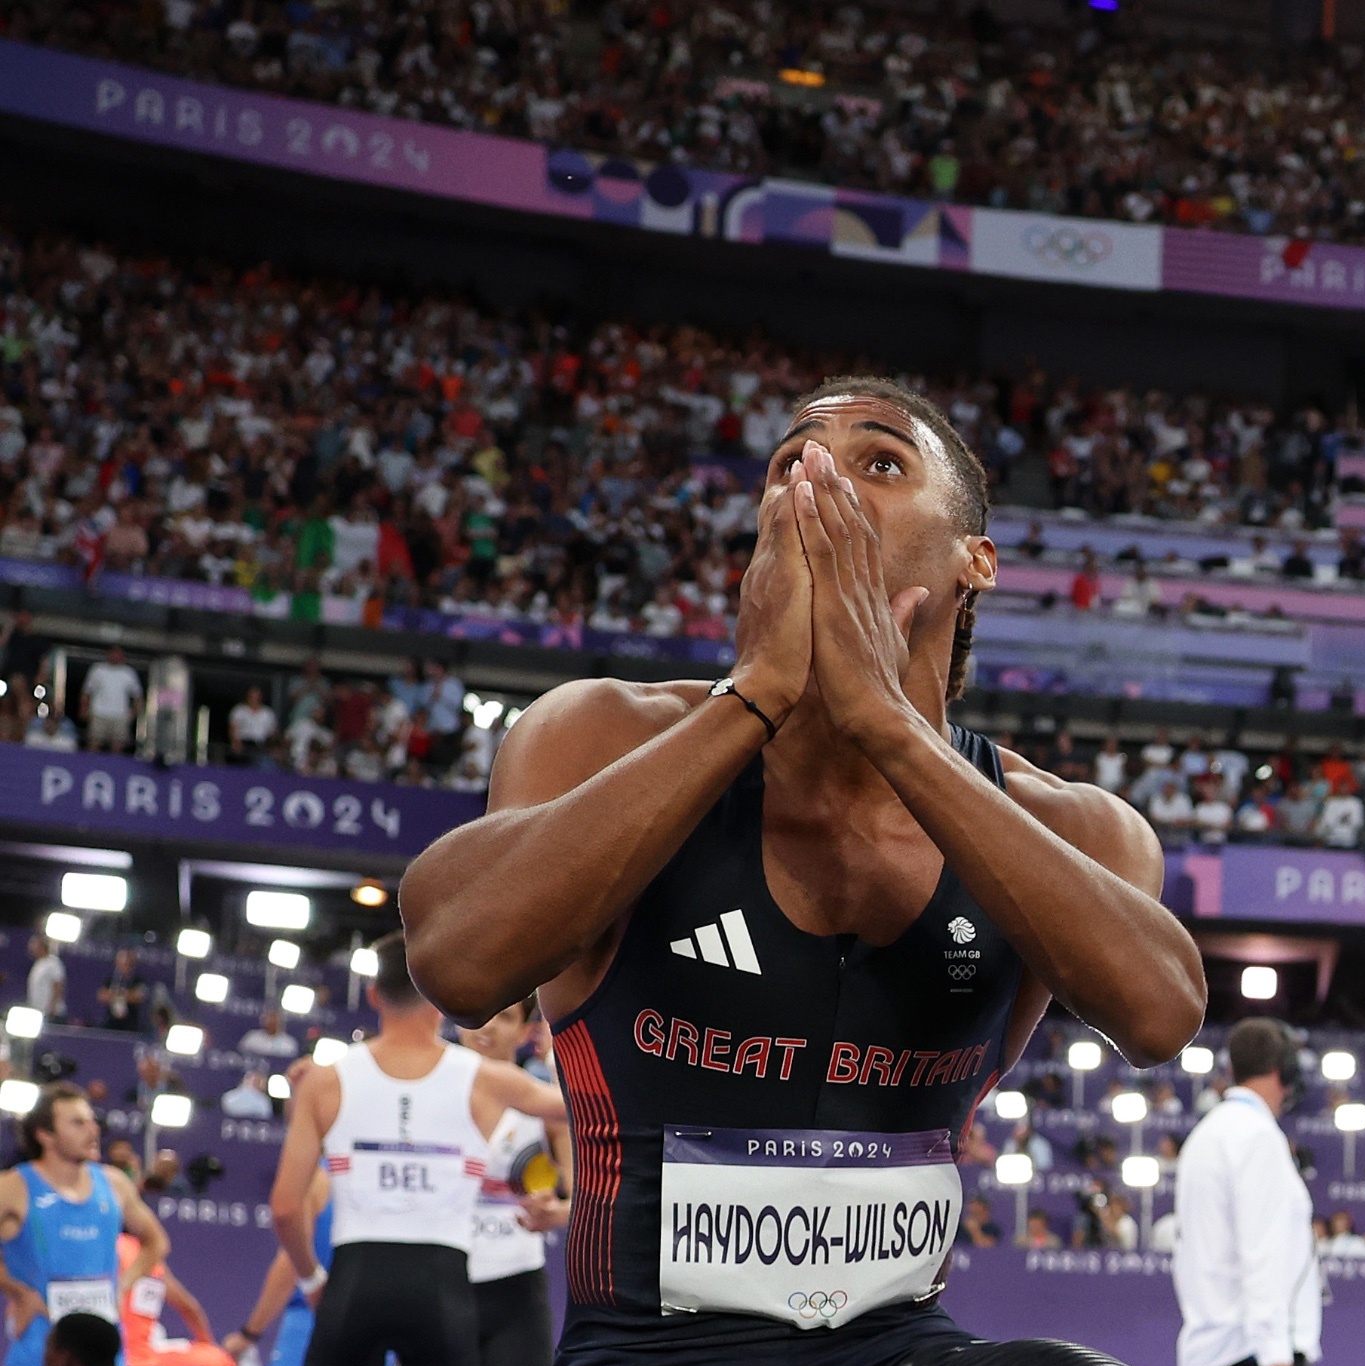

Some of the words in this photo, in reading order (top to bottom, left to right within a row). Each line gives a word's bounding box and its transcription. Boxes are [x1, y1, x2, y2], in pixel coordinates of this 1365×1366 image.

[286, 118, 431, 172] 2024
[41, 765, 221, 822] PARIS
[244, 786, 400, 838] 2024
[943, 950, 967, 959] TEAM
[967, 950, 981, 959] GB
[634, 1008, 807, 1080] GREAT
[825, 1039, 991, 1087] BRITAIN
[379, 1162, 434, 1192] BEL
[833, 1143, 892, 1159] 2024
[671, 1199, 951, 1266] HAYDOCK-WILSON
